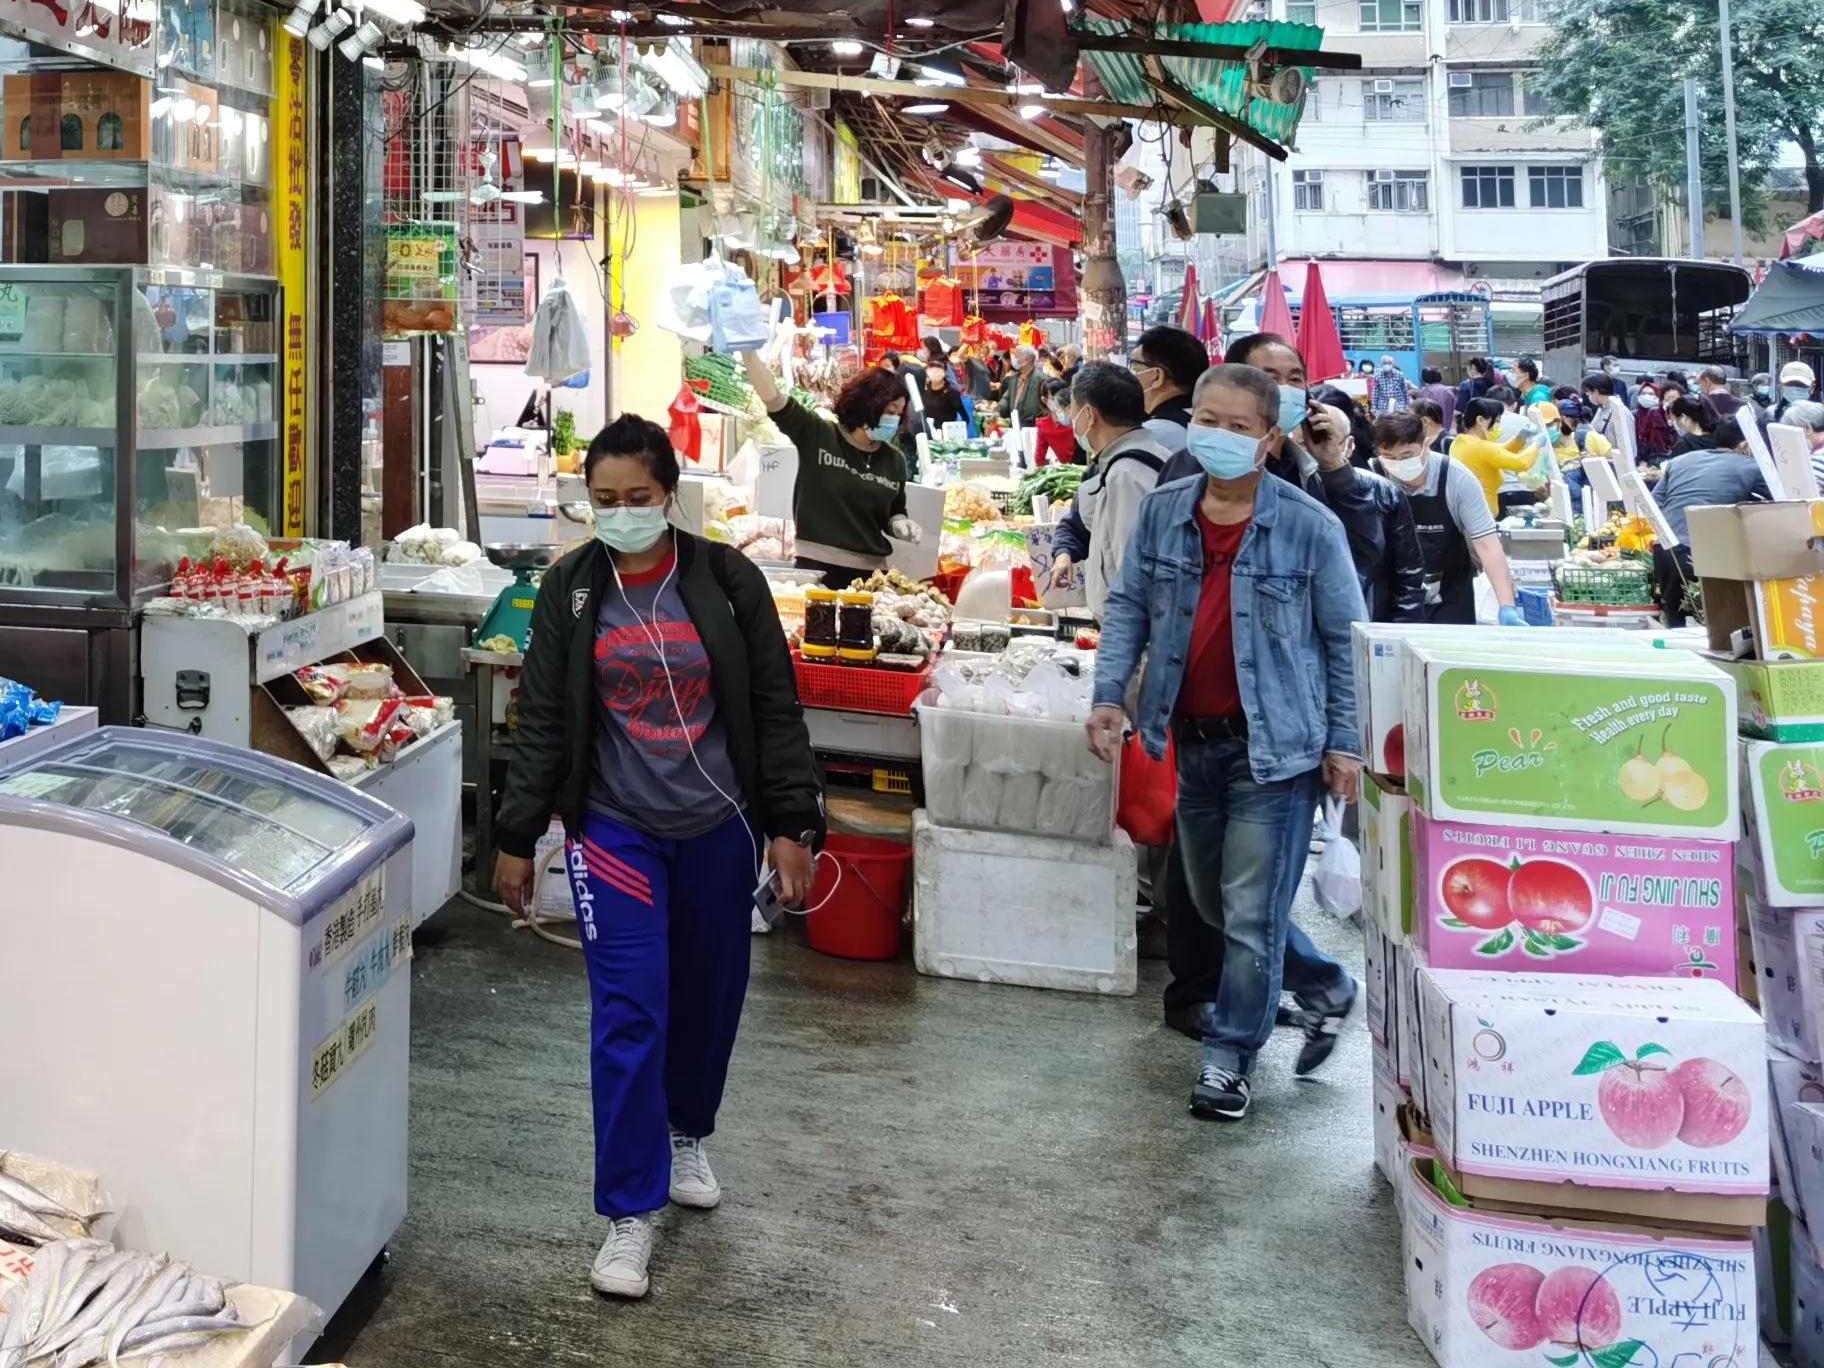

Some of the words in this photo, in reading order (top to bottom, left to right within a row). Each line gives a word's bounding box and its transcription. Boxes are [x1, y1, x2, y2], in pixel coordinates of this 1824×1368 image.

[1571, 705, 1612, 732] Fresh
[1613, 695, 1638, 714] and
[1639, 692, 1671, 709] good
[1674, 692, 1708, 705] taste
[1589, 719, 1628, 746] Health
[1625, 711, 1658, 730] every
[1658, 705, 1680, 721] day
[1472, 749, 1546, 778] Pear
[1443, 829, 1510, 849] FRUITS
[1516, 838, 1536, 850] LI
[1543, 841, 1608, 857] GUANG
[1616, 847, 1666, 861] ZHEN
[1673, 849, 1720, 863] SHEN
[1599, 872, 1614, 902] JI
[1615, 874, 1640, 904] FU
[1642, 875, 1681, 906] JING
[1682, 877, 1721, 907] SHUI
[1468, 1093, 1516, 1116] FUJI
[1522, 1097, 1594, 1122] APPLE
[1471, 1141, 1568, 1165] SHENZHEN
[1573, 1150, 1684, 1174] HONGXIANG
[1687, 1159, 1751, 1177] FRUITS
[1472, 1231, 1536, 1254] FRUITS
[1541, 1242, 1650, 1268] HONGXIANG
[1650, 1252, 1747, 1274] SHENZHEN
[1628, 1296, 1705, 1320] APPLE
[1705, 1302, 1747, 1321] FUJI
